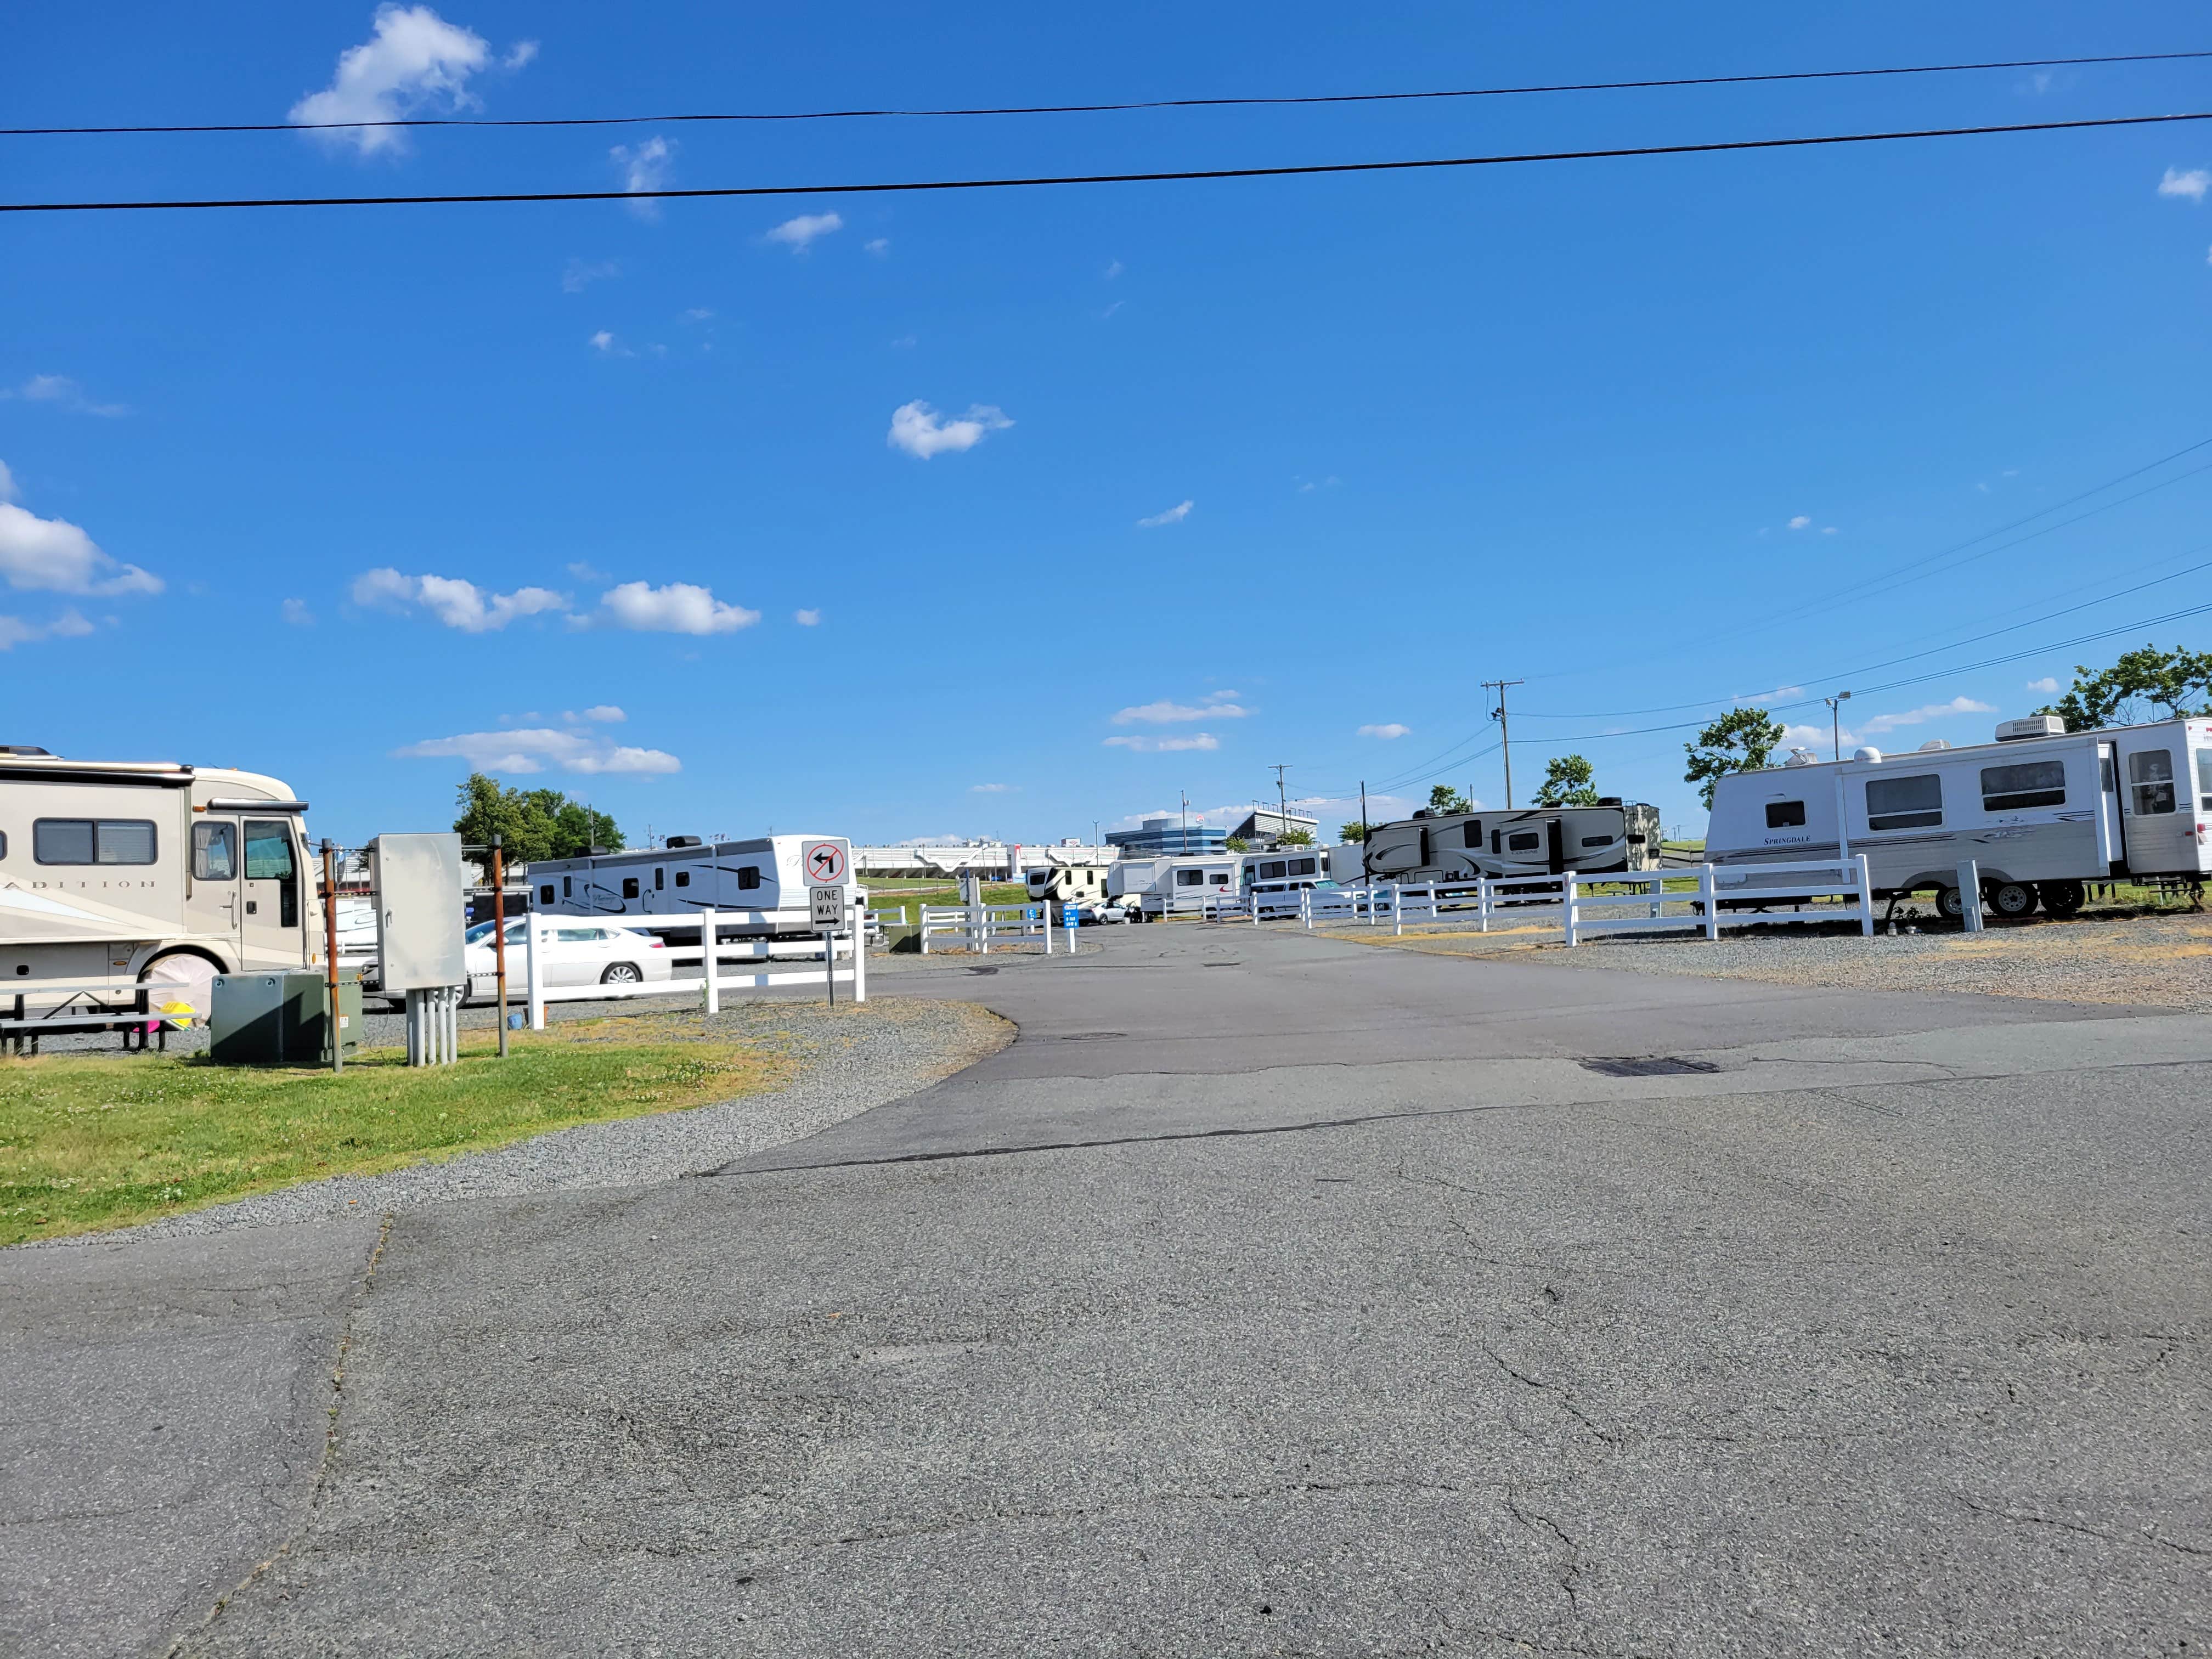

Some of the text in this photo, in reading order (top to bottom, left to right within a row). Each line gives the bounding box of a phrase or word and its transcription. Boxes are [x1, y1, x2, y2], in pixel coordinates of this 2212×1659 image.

[1764, 835, 1811, 845] SPRINGDALE
[816, 890, 838, 901] ONE
[816, 904, 838, 916] WAY
